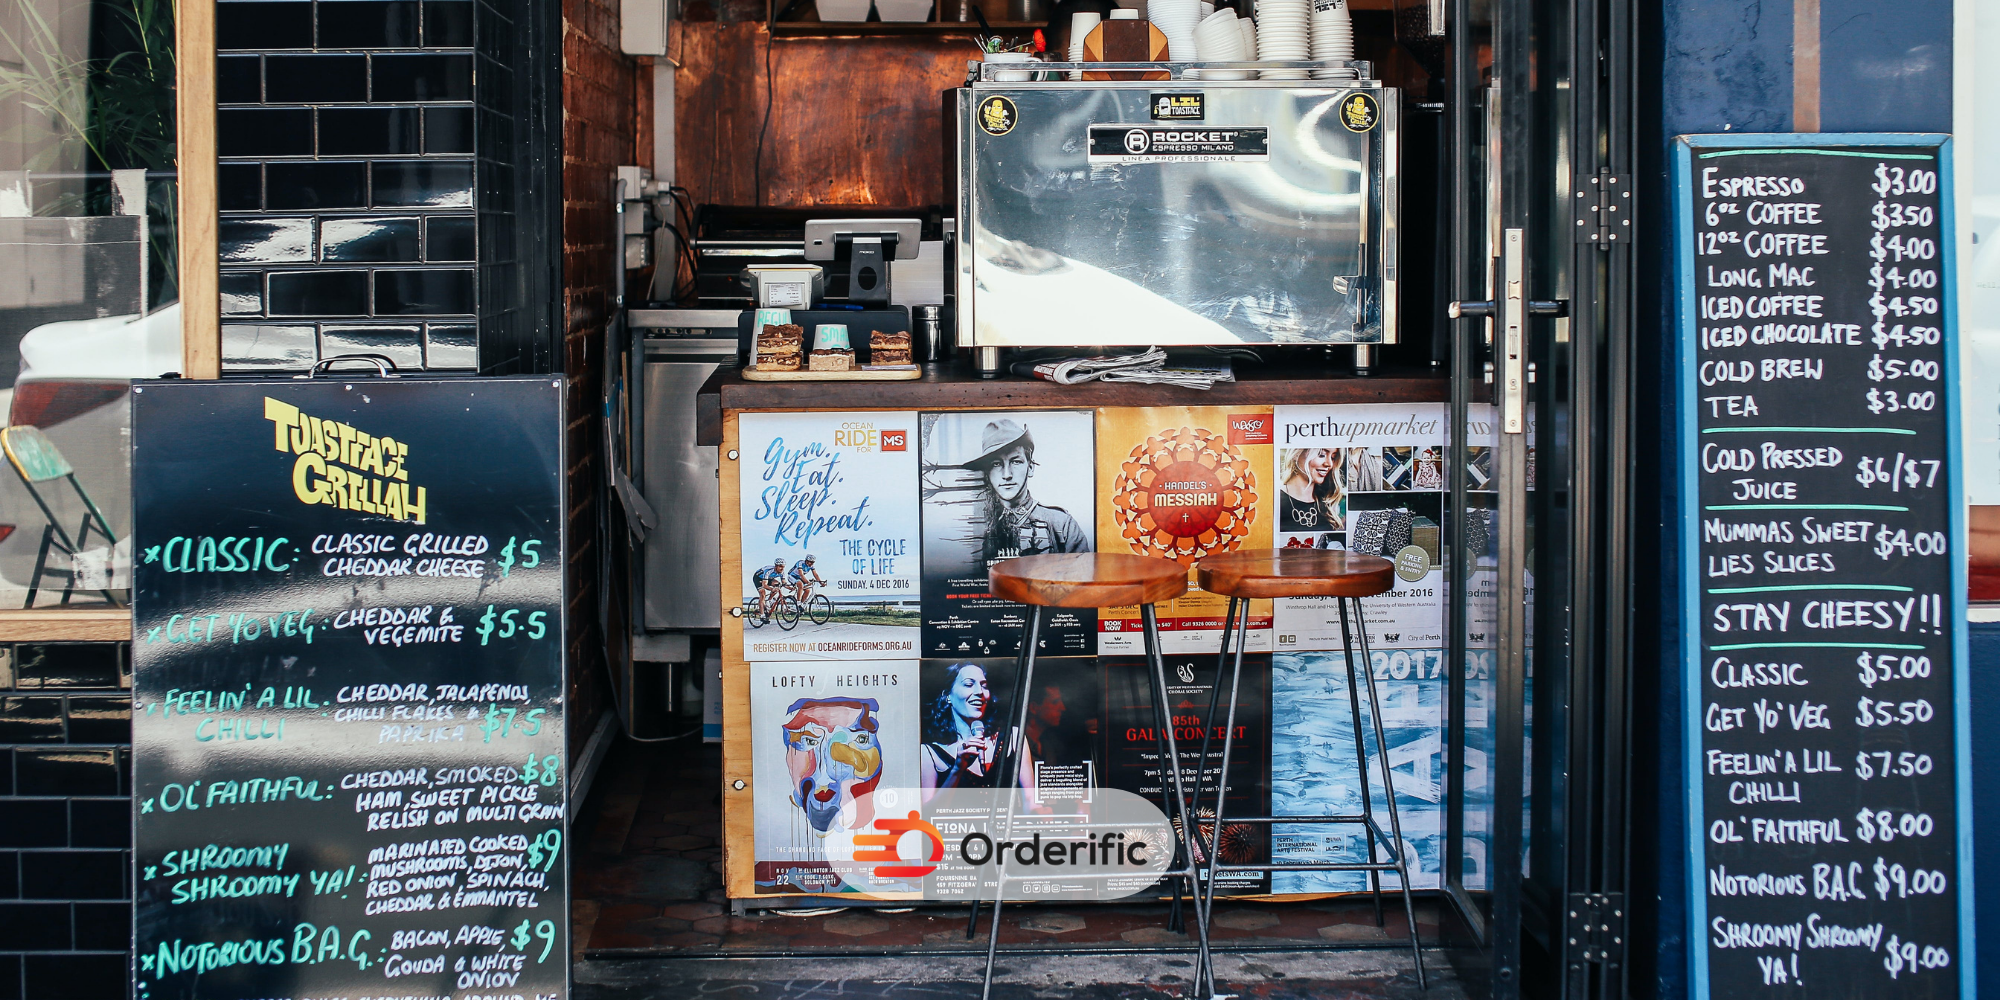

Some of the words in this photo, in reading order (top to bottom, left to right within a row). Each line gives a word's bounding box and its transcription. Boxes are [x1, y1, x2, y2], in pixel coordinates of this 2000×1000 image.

[1702, 167, 1805, 198] ESPRESSO
[1872, 163, 1936, 198] $3.00
[1747, 201, 1822, 225] COFFEE
[1871, 200, 1933, 231] $3.50
[1744, 231, 1830, 258] COFFEE
[1869, 232, 1935, 262] $4.00
[1708, 265, 1761, 288] LONG
[1768, 263, 1816, 287] MAC
[1868, 262, 1937, 292] $4.00
[1701, 296, 1743, 320] ICED
[1746, 295, 1824, 319] COFFEE
[1868, 291, 1938, 322] $4.50
[1702, 327, 1747, 350] ICED
[1751, 323, 1862, 346] CHOCOLATE
[1872, 321, 1940, 350] $4.50
[1700, 360, 1754, 386] COLD
[1761, 358, 1823, 381] BREW
[1867, 354, 1939, 382] $5.00
[1704, 395, 1759, 418] TEA
[1866, 388, 1935, 414] $3.00
[264, 396, 409, 481] TOASTFACE
[834, 430, 877, 446] RIDE
[842, 422, 874, 430] OCEAN
[884, 435, 904, 446] MS
[1284, 414, 1438, 443] perthupmarket
[763, 437, 830, 481] Gym.
[791, 452, 844, 494] Eat.
[1702, 443, 1755, 474] COLD
[1761, 442, 1843, 470] PRESSED
[1855, 452, 1940, 492] $6/$7
[292, 452, 426, 524] GRILLAH
[754, 480, 836, 520] Sleep.
[1154, 493, 1217, 507] MESSIAH
[1164, 482, 1207, 490] HANDEL'S
[1732, 479, 1797, 500] JUICE
[774, 496, 873, 549] Repeat.
[1704, 518, 1794, 544] MUMMAS
[1802, 517, 1874, 544] SWEET
[311, 534, 396, 554] CLASSIC
[403, 533, 489, 555] GRILLED
[498, 536, 541, 578] $5
[839, 539, 862, 556] THE
[868, 539, 906, 556] CYCLE
[1874, 524, 1946, 561] $4.00
[323, 558, 413, 578] CHEDDAR
[416, 558, 485, 579] CHEESE
[852, 558, 866, 575] OF
[872, 558, 895, 575] LIFE
[1405, 554, 1423, 562] FREE
[1708, 554, 1754, 577] LIES
[1764, 551, 1836, 574] SLICES
[838, 580, 868, 590] SUNDAY,
[869, 580, 874, 588] 4
[876, 580, 891, 588] DEC
[893, 579, 909, 588] 2016
[166, 614, 220, 644] GET
[228, 613, 261, 644] YO
[334, 605, 432, 629] CHEDDAR
[439, 606, 454, 624] &
[476, 604, 547, 646] $5.5
[1713, 600, 1790, 632] STAY
[1802, 594, 1942, 635] CHEESY!!
[364, 625, 464, 647] VEGEMITE
[753, 643, 787, 653] REGISTER
[789, 643, 806, 652] NOW
[808, 643, 816, 652] AT
[818, 641, 912, 652] OCEANRIDEFORMS.ORG.AU
[772, 676, 816, 687] LOFTY
[837, 674, 898, 687] HEIGHTS
[1373, 651, 1442, 680] 2017
[1711, 657, 1808, 688] CLASSIC
[1857, 651, 1930, 689] $5.00
[480, 703, 546, 743] $7.5
[1172, 715, 1200, 726] 85th
[1706, 702, 1746, 731] GET
[1789, 700, 1831, 730] VEG
[1855, 696, 1933, 727] $5.50
[435, 766, 518, 785] SMOKED
[519, 752, 560, 786] $8
[1706, 749, 1781, 776] FEELIN'
[1785, 751, 1797, 773] A
[1803, 748, 1842, 773] LIL
[1855, 751, 1932, 780] $7.50
[410, 787, 475, 810] SWEET
[480, 784, 539, 804] PICKLE
[1729, 781, 1800, 804] CHILLI
[367, 809, 429, 832] RELISH
[434, 808, 459, 826] ON
[518, 802, 565, 823] GRAIN
[1751, 818, 1850, 844] FAITHFUL
[1856, 807, 1933, 843] $8.00
[162, 842, 289, 877] SHROOMY
[368, 838, 466, 864] MARINATED
[469, 834, 529, 853] COOKED
[527, 828, 562, 872] $9
[171, 873, 300, 904] SHROOMY
[366, 880, 402, 898] RED
[1710, 864, 1806, 896] NOTORIOUS
[1873, 856, 1946, 901] $9.00
[365, 893, 435, 916] CHEDDAR
[510, 919, 556, 964] $9
[1712, 916, 1802, 951] SHROOMY
[1807, 913, 1883, 952] SHROOMY
[1884, 934, 1949, 979] $9.00
[156, 938, 285, 980] NOTORIOUS
[384, 954, 446, 979] GOUDA
[471, 953, 527, 972] WHITE
[1758, 953, 1803, 986] YA!
[457, 972, 520, 990] ONION
